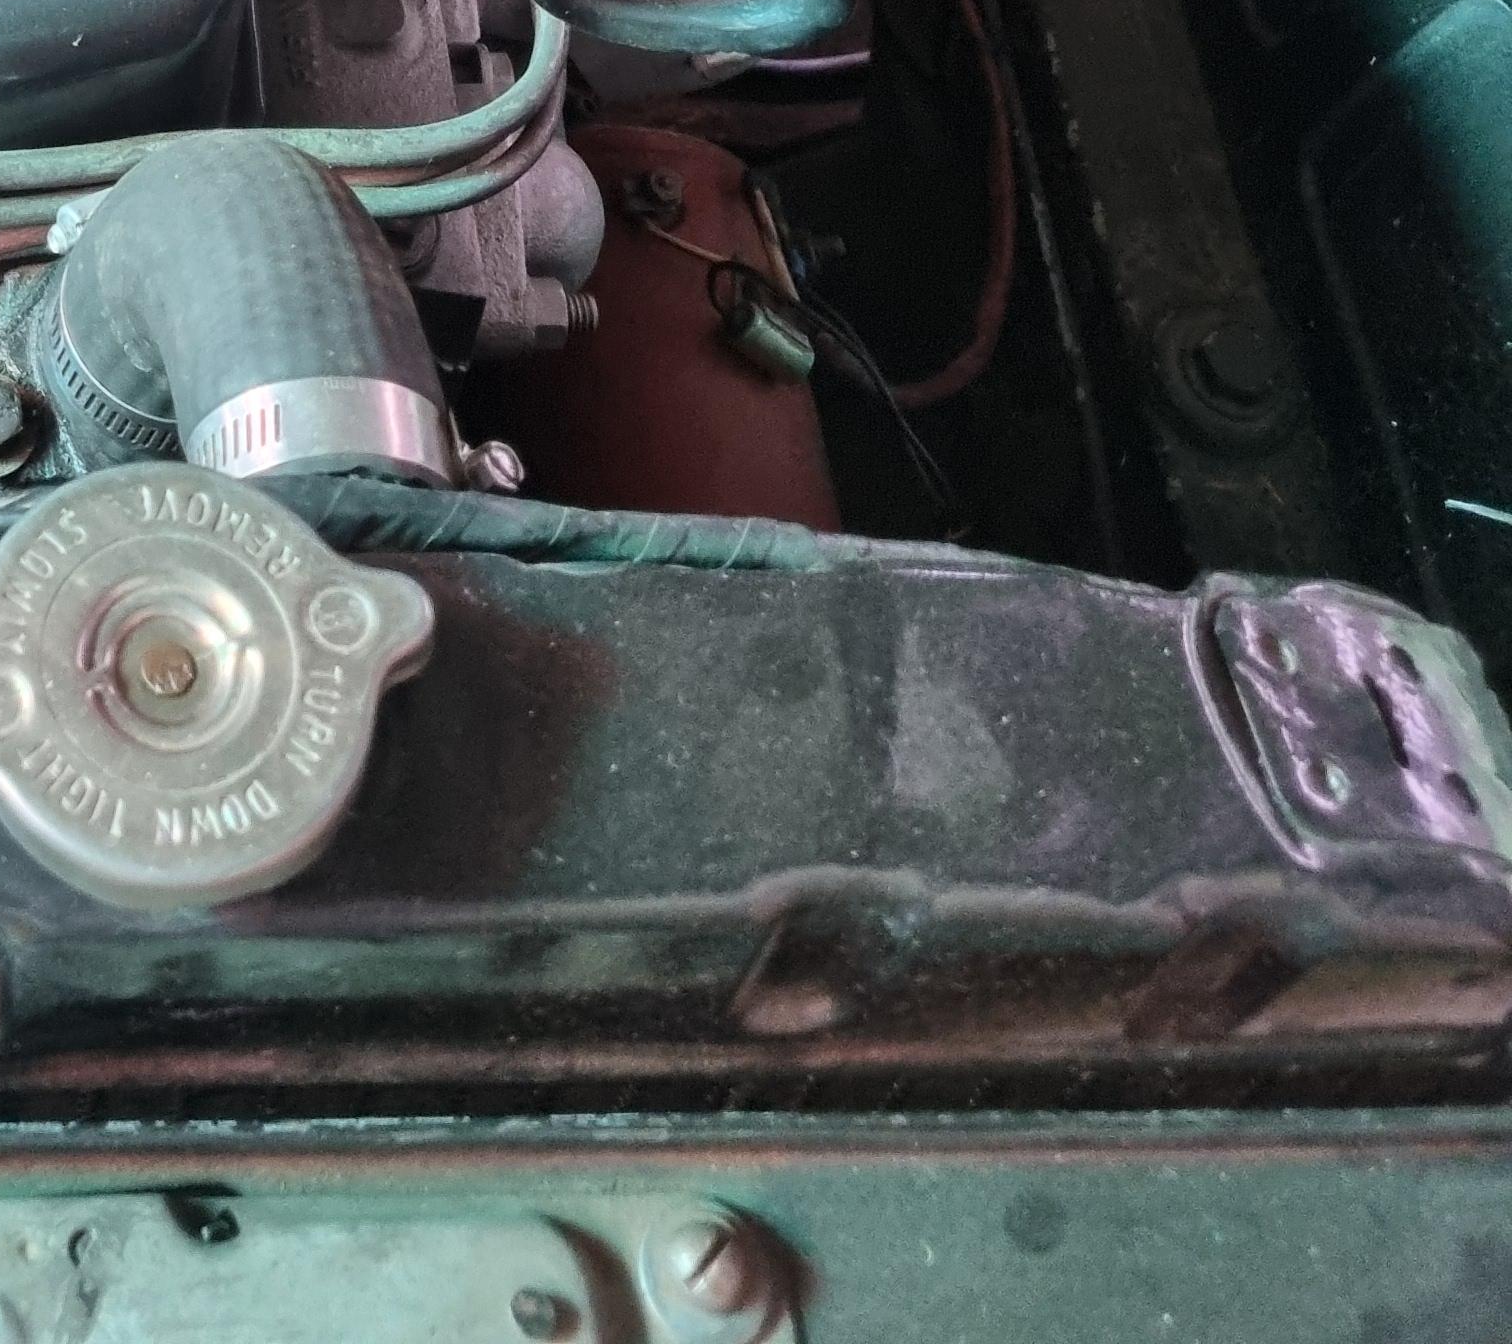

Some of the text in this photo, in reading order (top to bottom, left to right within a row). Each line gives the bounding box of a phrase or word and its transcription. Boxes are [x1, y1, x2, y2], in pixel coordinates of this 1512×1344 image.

[17, 664, 342, 847] TURN DOWN TIGHT
